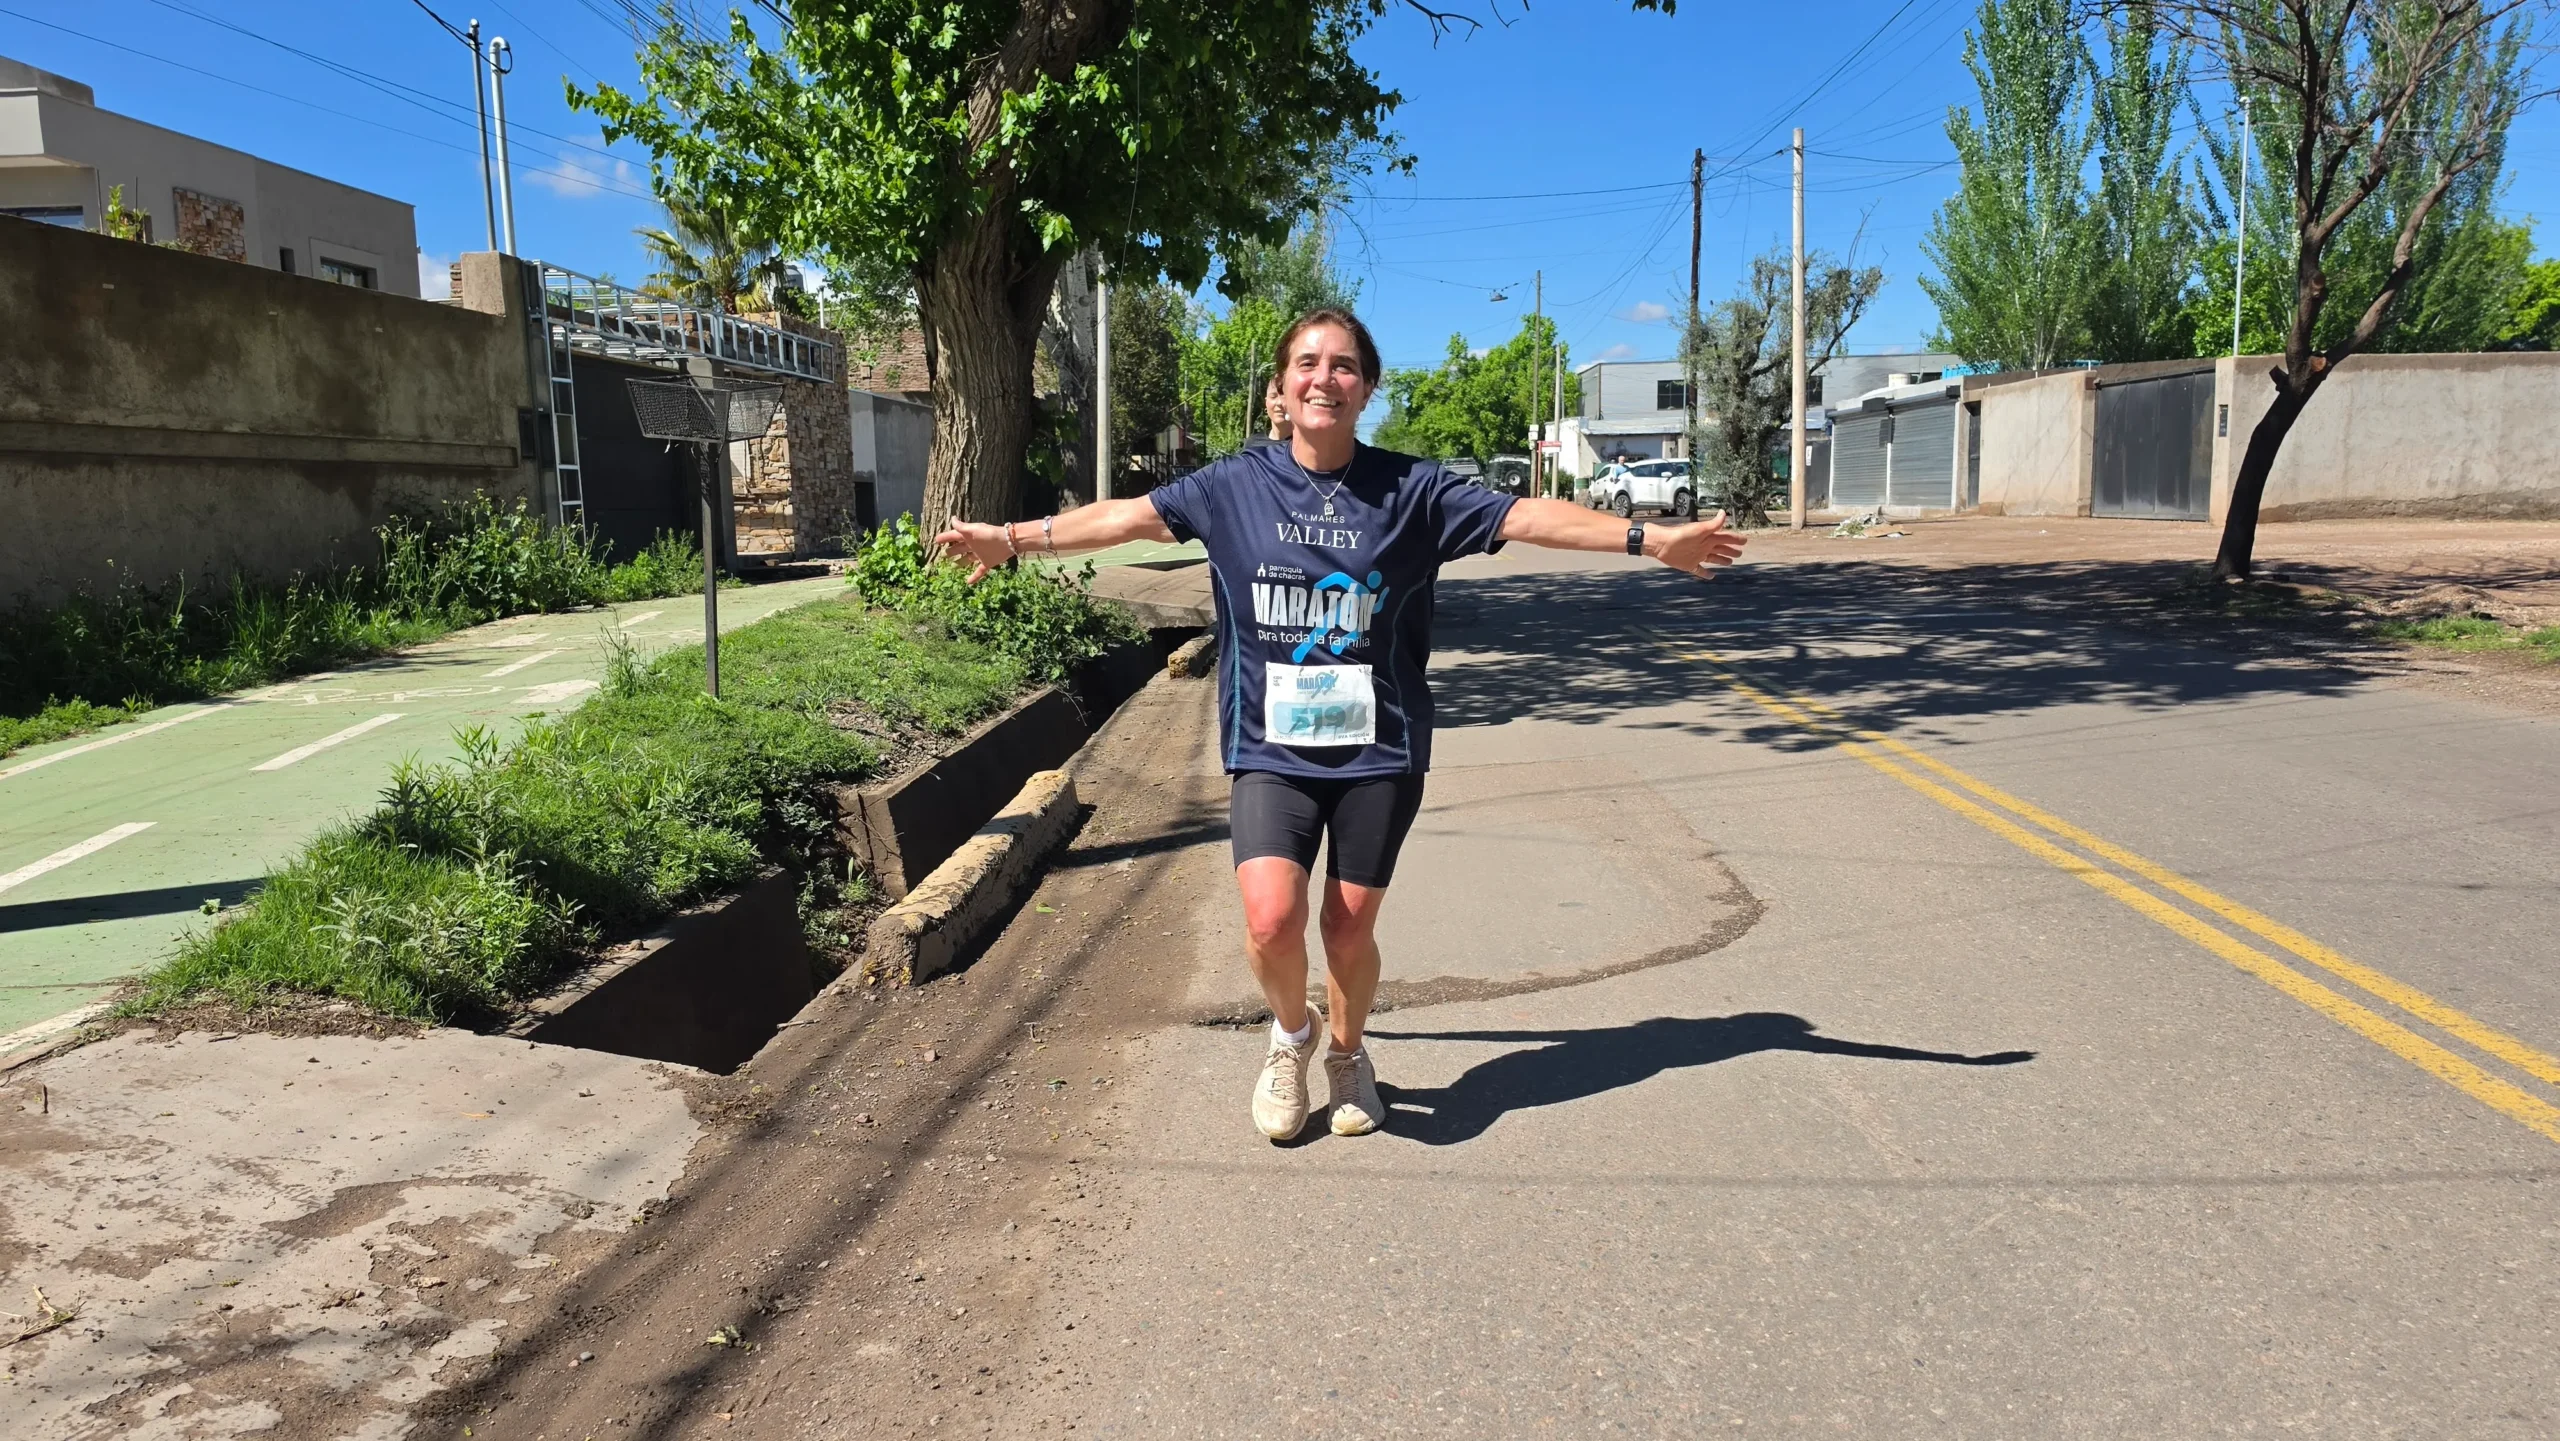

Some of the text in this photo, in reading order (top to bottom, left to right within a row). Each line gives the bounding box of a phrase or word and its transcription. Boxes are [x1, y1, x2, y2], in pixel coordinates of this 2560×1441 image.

[1291, 510, 1346, 524] PALMARES
[1275, 522, 1363, 549] VALLEY
[1268, 564, 1303, 575] parroquia
[1278, 572, 1306, 581] chacras
[1251, 582, 1378, 633] MARATÓN
[1279, 631, 1311, 644] toda
[1314, 631, 1325, 645] la
[1328, 633, 1371, 649] familia
